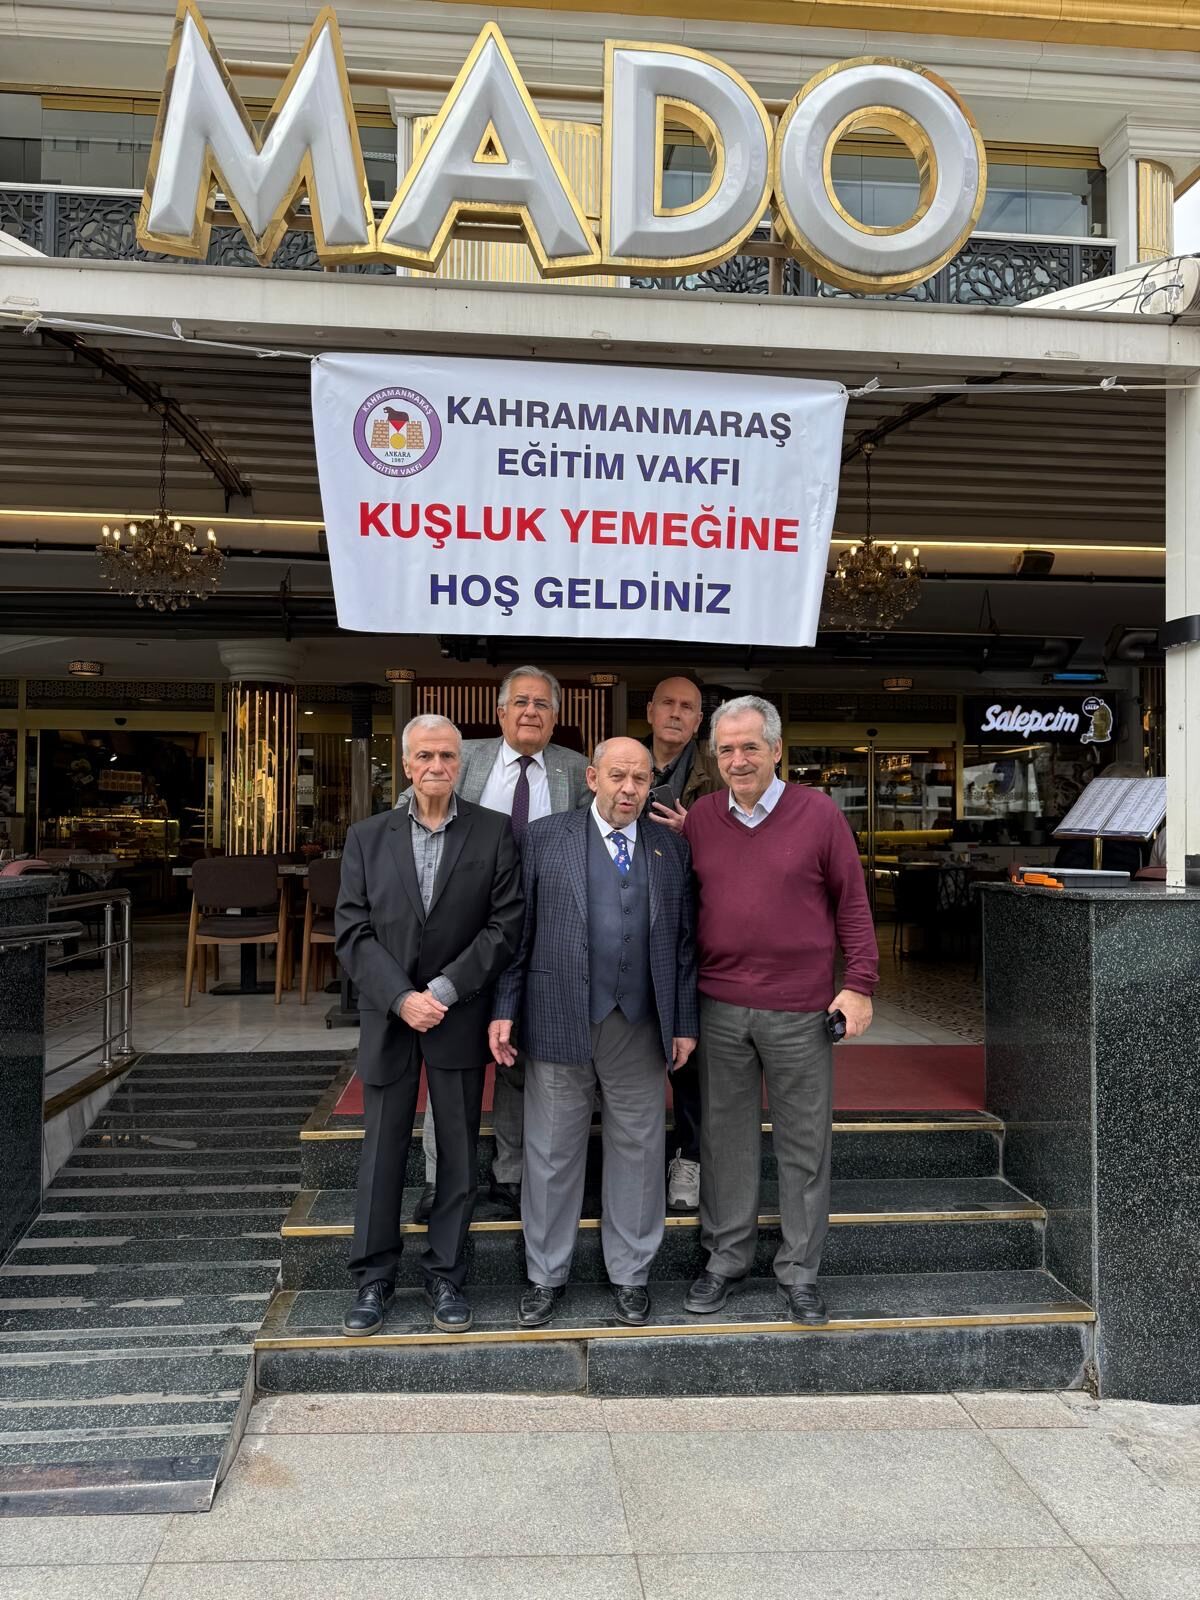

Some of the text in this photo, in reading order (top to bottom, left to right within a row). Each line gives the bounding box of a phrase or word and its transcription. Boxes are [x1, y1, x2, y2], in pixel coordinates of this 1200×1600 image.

[135, 0, 989, 295] MADO
[361, 388, 434, 415] KAHRAMANMARAŞ
[447, 395, 792, 448] KAHRAMANMARAŞ
[371, 460, 423, 475] EĞİTİM VAKFI
[498, 440, 740, 487] EĞİTİM VAKFI
[359, 501, 800, 553] KUŞLUK YEMEĞİNE
[430, 570, 732, 617] HOŞ GELDİNİZ
[980, 704, 1080, 739] Salepcim
